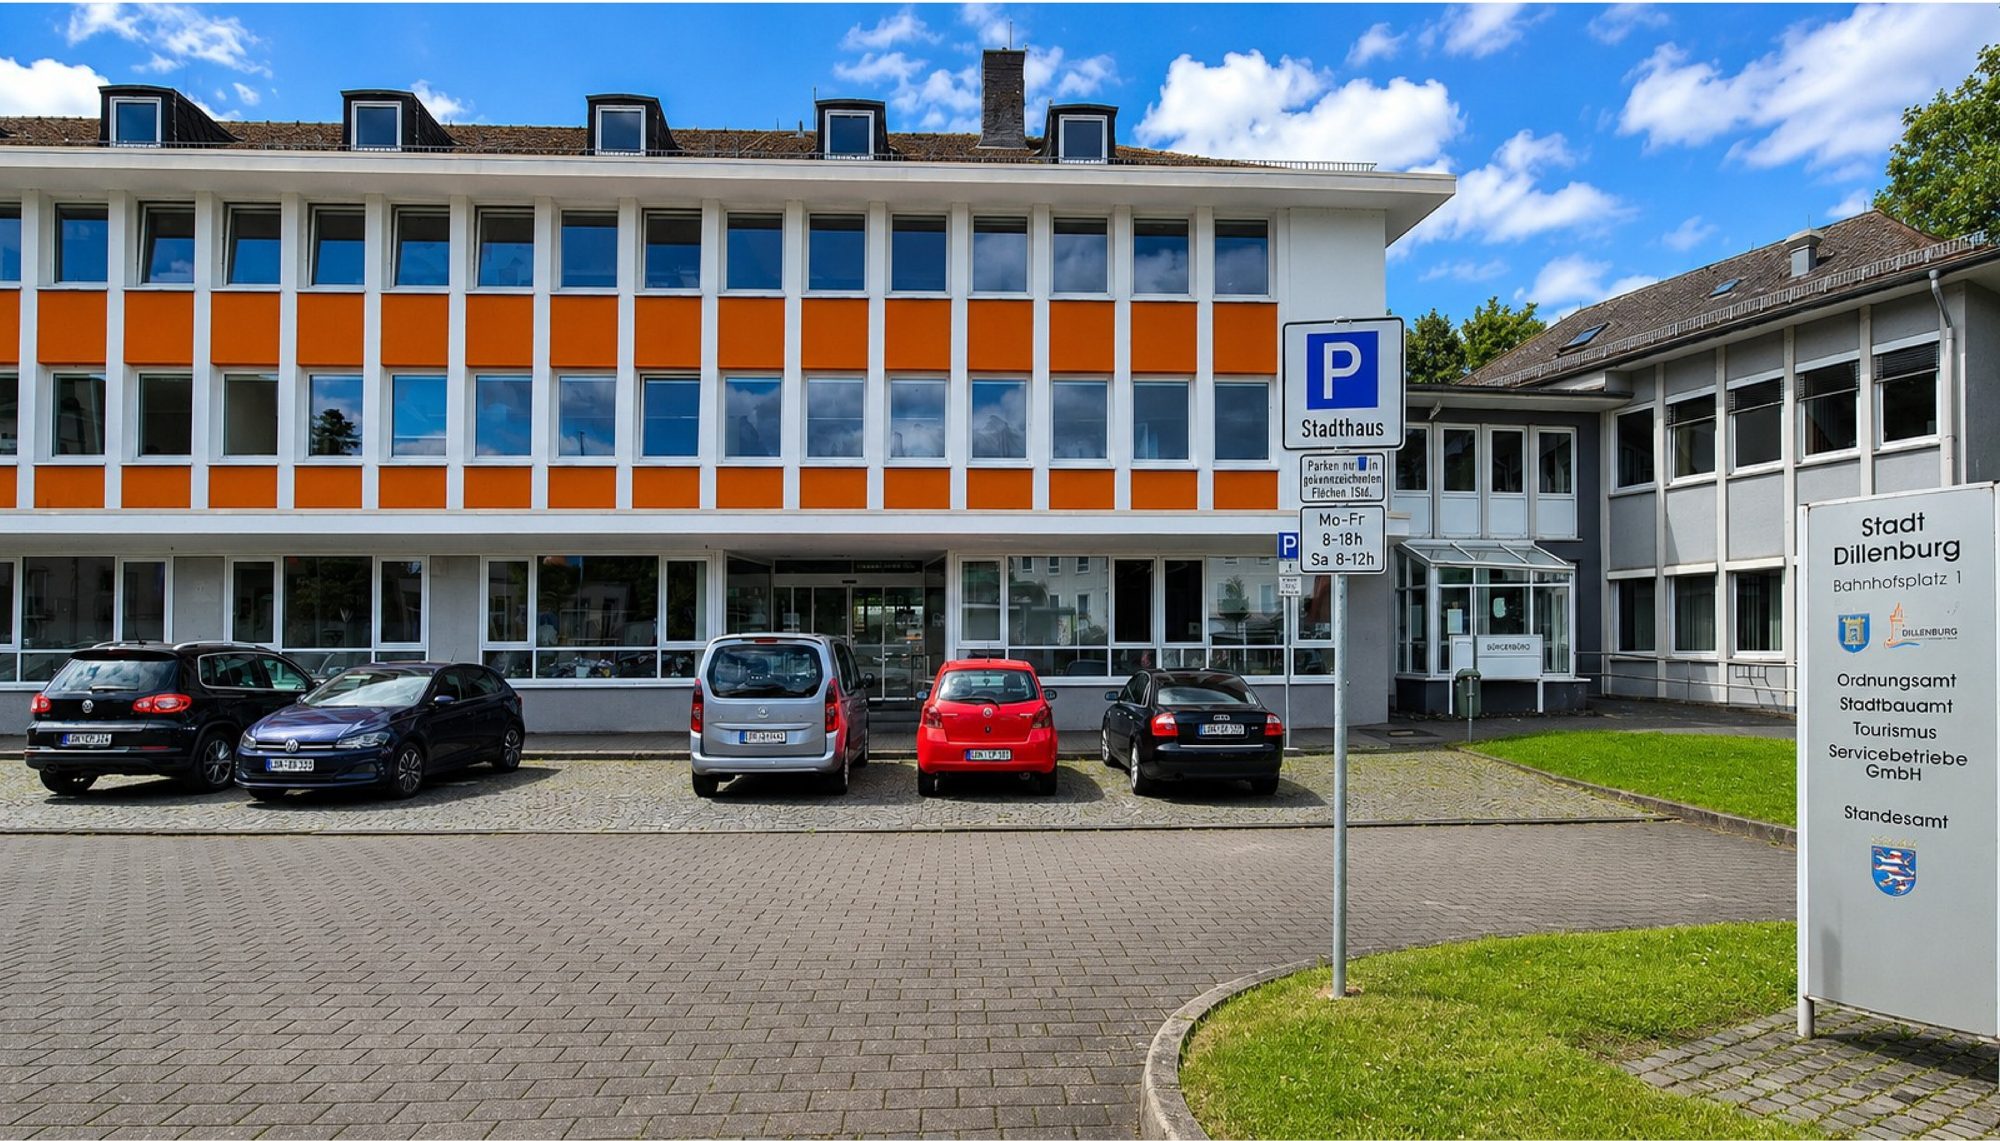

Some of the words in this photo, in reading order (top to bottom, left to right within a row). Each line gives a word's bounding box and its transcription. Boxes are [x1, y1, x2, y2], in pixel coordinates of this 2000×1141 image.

[1323, 341, 1362, 400] P
[1301, 418, 1384, 438] Stadthaus
[1308, 460, 1340, 471] Parken
[1319, 512, 1365, 527] Mo-Fr
[1861, 511, 1925, 537] Stadt
[1283, 535, 1297, 556] P
[1322, 532, 1363, 546] 8-18h
[1311, 552, 1329, 566] Sa
[1336, 551, 1375, 566] 8-12h
[1833, 539, 1961, 566] Dillenburg
[1833, 572, 1948, 593] Bahnhofsplatz
[1956, 569, 1962, 584] 1
[1902, 627, 1958, 637] DILLENBURG
[1837, 673, 1957, 691] Ordnungsamt
[1839, 696, 1953, 713] Stadtbauamt
[1853, 721, 1937, 740] Tourismus
[1828, 743, 1968, 767] Servicebetriebe
[1865, 763, 1922, 781] GmbH
[1844, 804, 1949, 829] Standesamt
